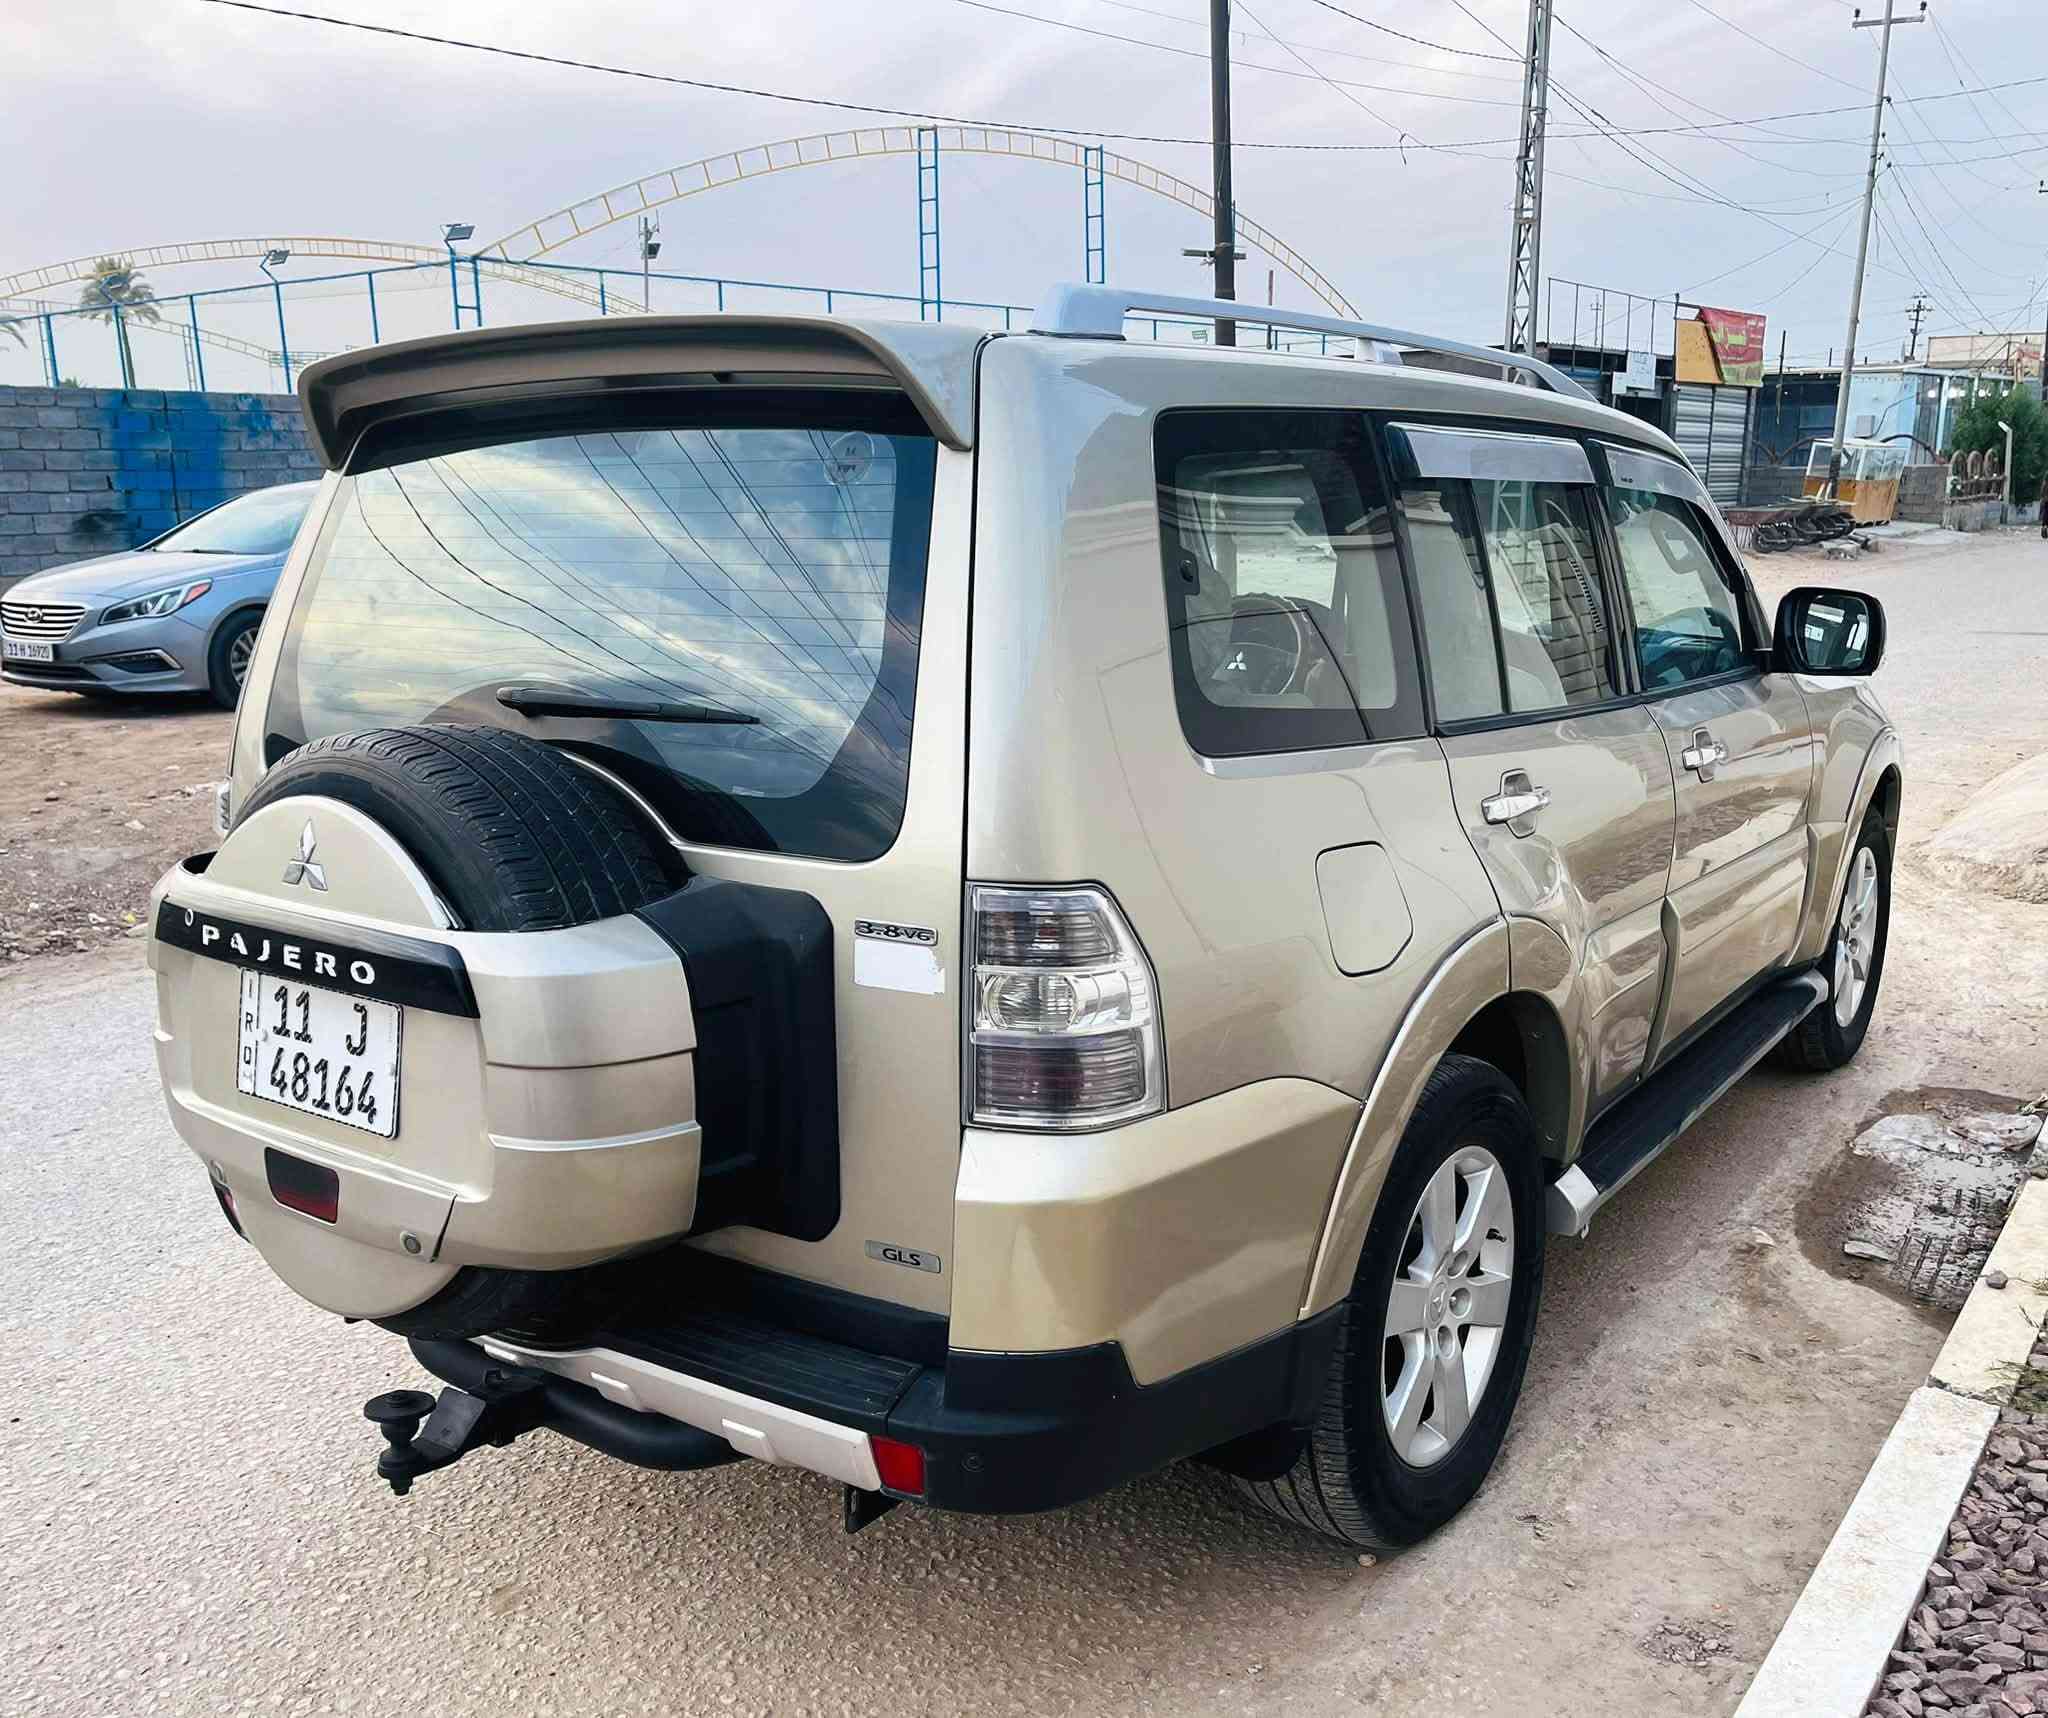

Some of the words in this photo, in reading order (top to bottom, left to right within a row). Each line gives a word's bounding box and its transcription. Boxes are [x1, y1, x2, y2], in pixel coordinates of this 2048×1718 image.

[202, 924, 376, 985] PAJERO
[272, 985, 313, 1043] 11
[346, 1003, 368, 1057] J
[270, 1047, 377, 1125] 48164
[882, 1248, 921, 1266] GLS
